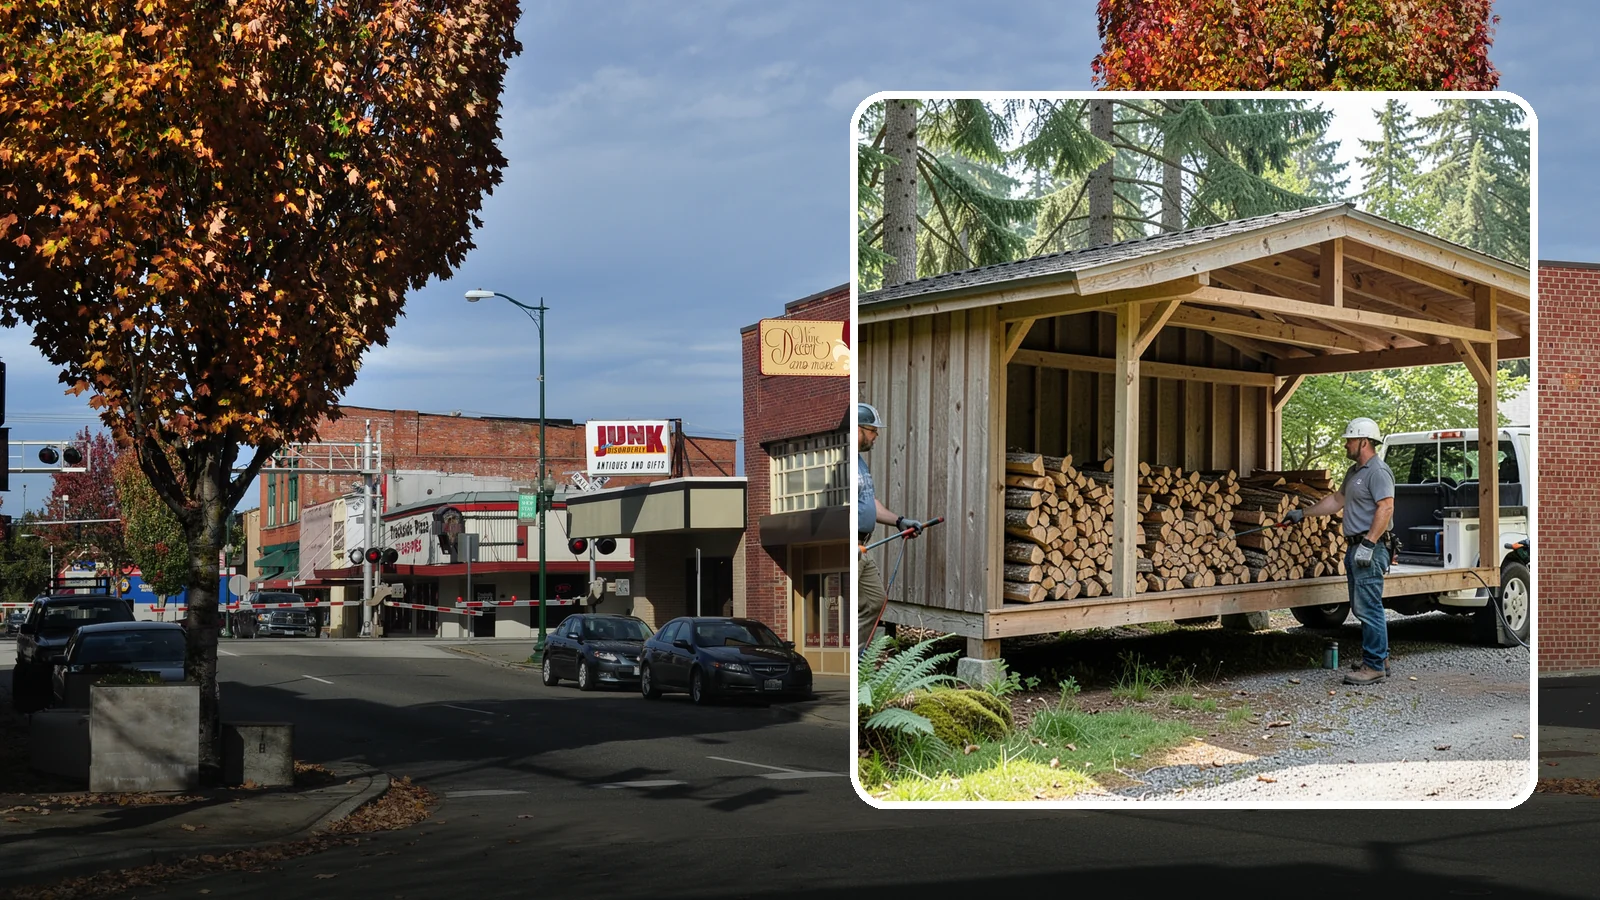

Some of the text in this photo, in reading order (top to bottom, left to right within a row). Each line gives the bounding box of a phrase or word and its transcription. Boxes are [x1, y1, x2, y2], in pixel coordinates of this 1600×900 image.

[595, 425, 664, 457] JUNK
[596, 461, 665, 470] ANTIQUES AND GIFTS
